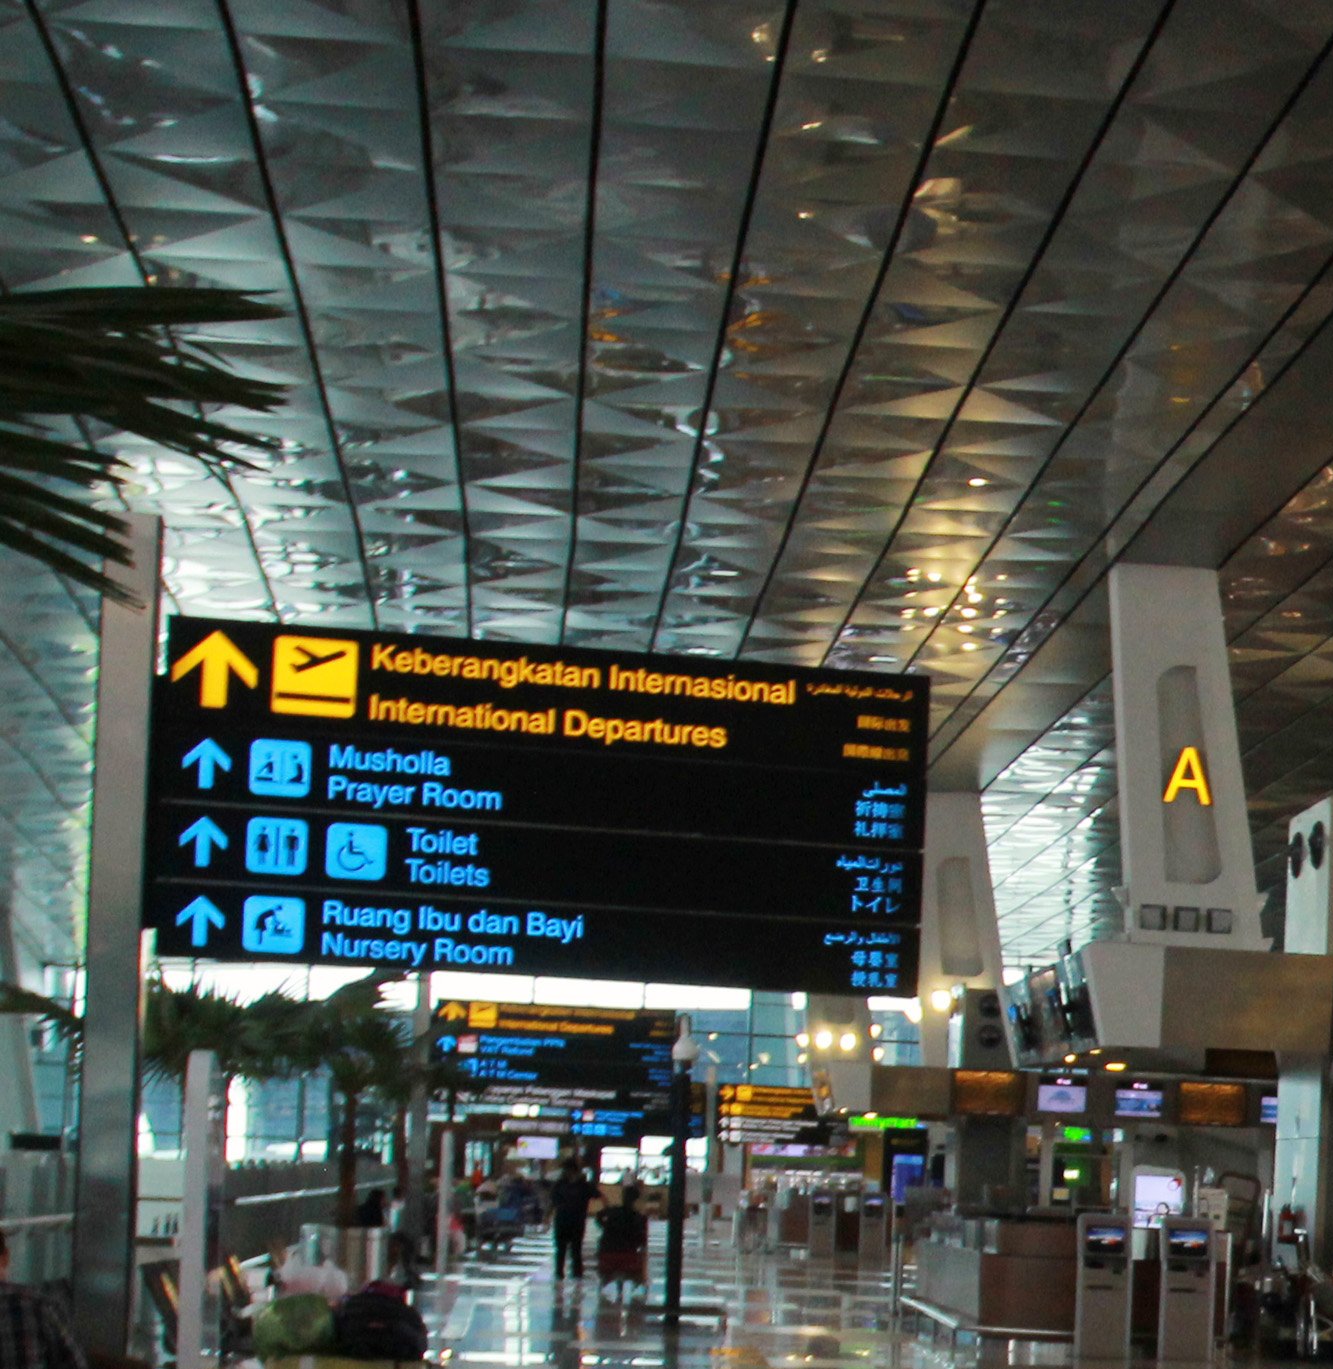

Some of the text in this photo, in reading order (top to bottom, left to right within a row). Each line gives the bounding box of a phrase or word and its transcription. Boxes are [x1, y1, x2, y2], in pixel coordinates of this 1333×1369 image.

[371, 643, 797, 705] Keberangkatan Internasional
[368, 693, 728, 748] International Departures
[328, 743, 451, 776] Musholla
[1161, 747, 1212, 807] A
[327, 774, 503, 811] Prayer Room
[405, 826, 480, 856] Toilet
[404, 857, 491, 888] Toilets
[321, 899, 585, 944] Ruang Ibu dan Bayi
[851, 895, 902, 913] トイレ
[321, 932, 515, 967] Nursery Room
